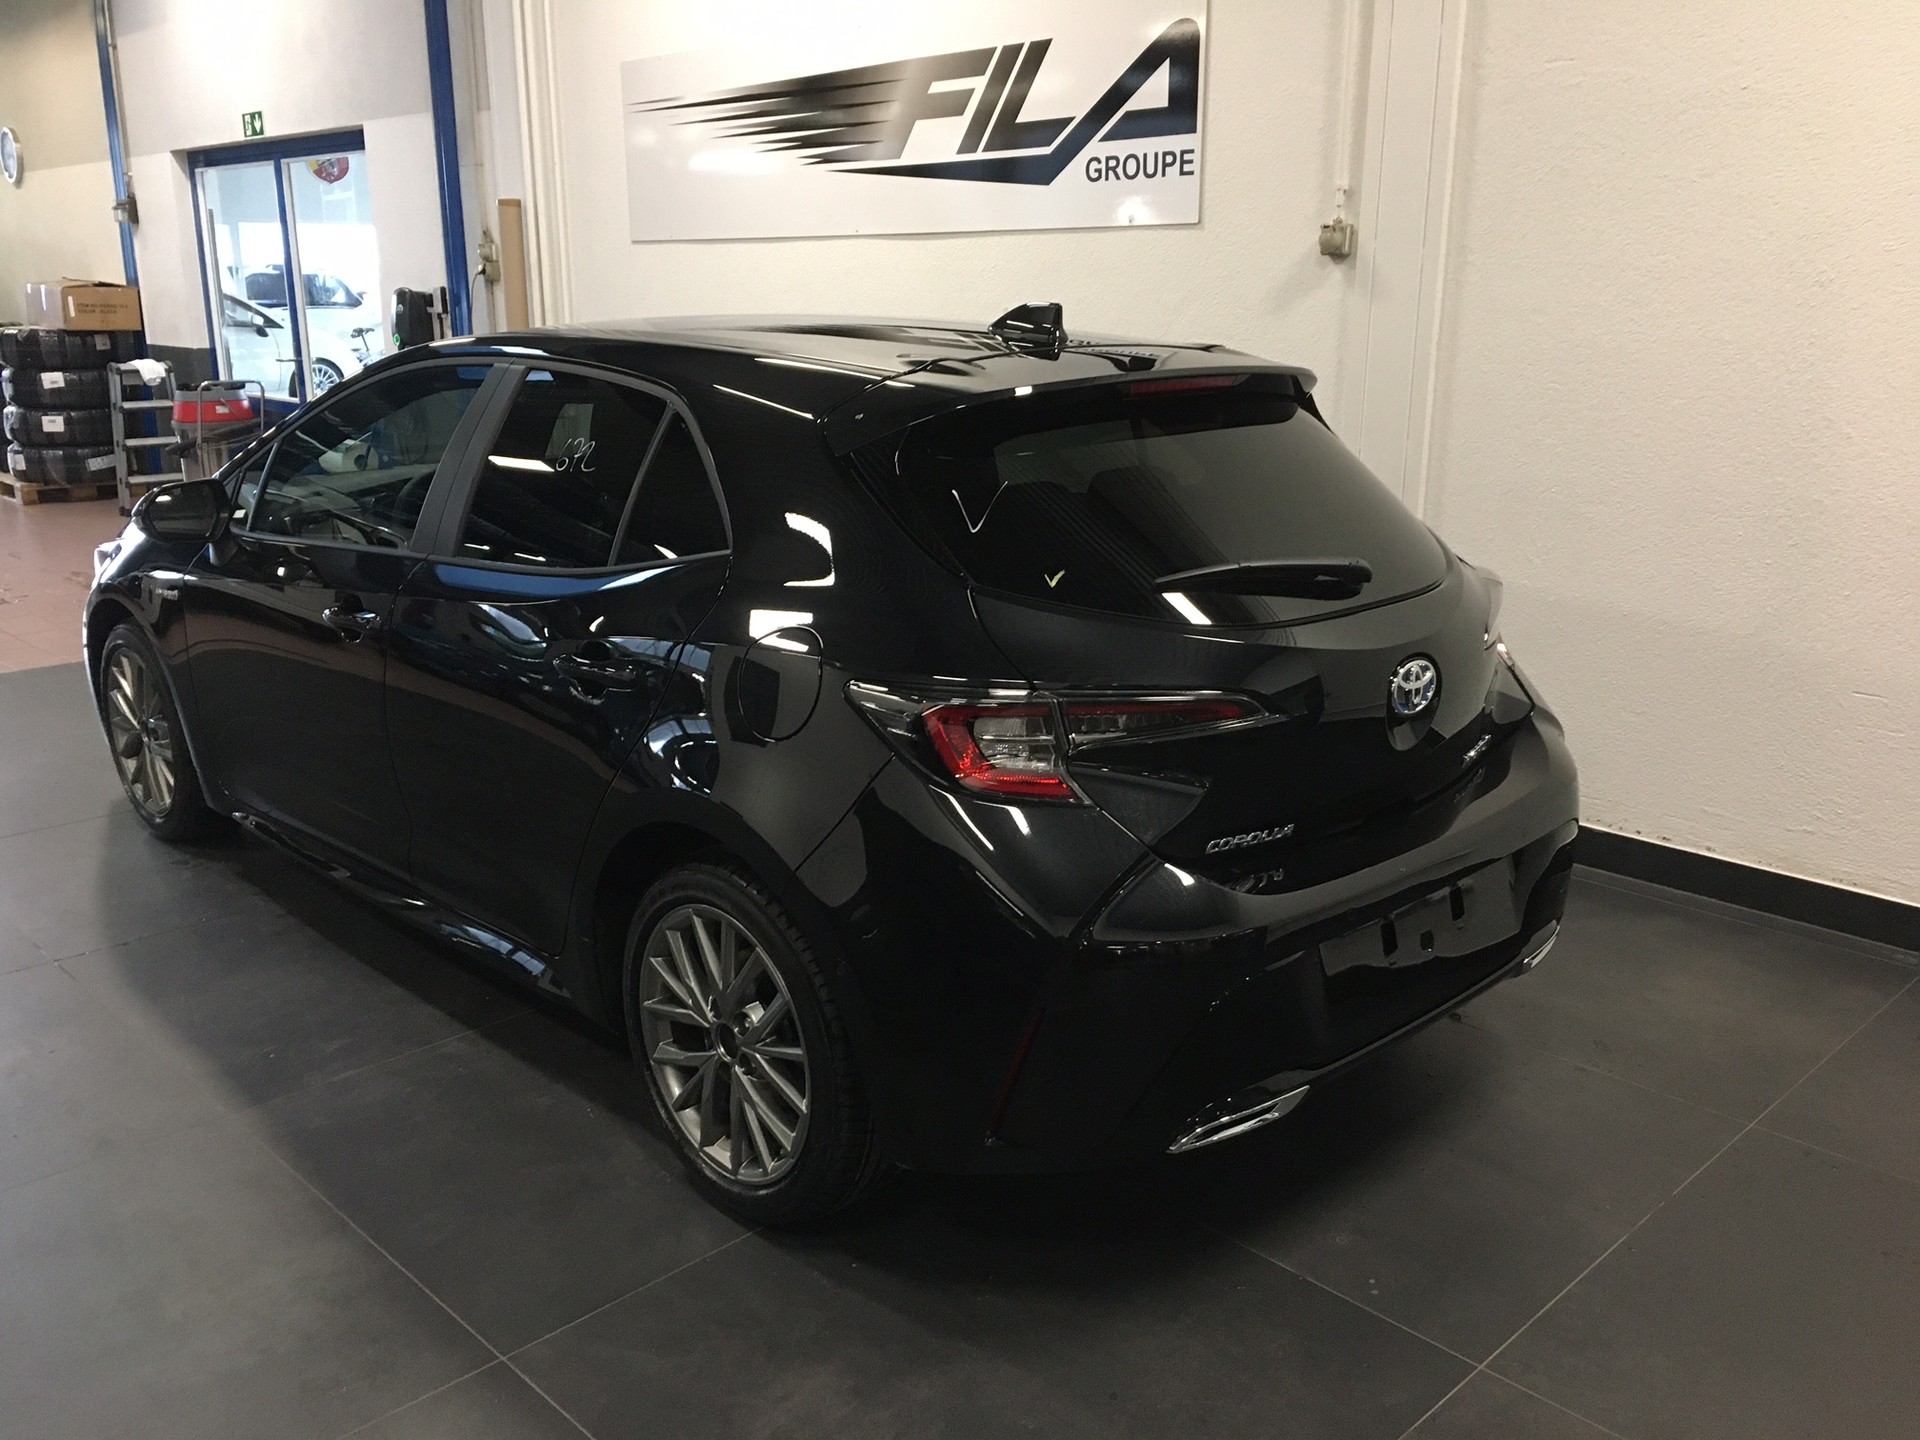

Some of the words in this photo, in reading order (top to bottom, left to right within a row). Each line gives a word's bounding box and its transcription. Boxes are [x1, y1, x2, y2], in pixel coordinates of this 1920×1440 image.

[880, 18, 1200, 186] FILA
[1086, 149, 1195, 183] GROUPE
[1205, 823, 1295, 854] COROLLA
